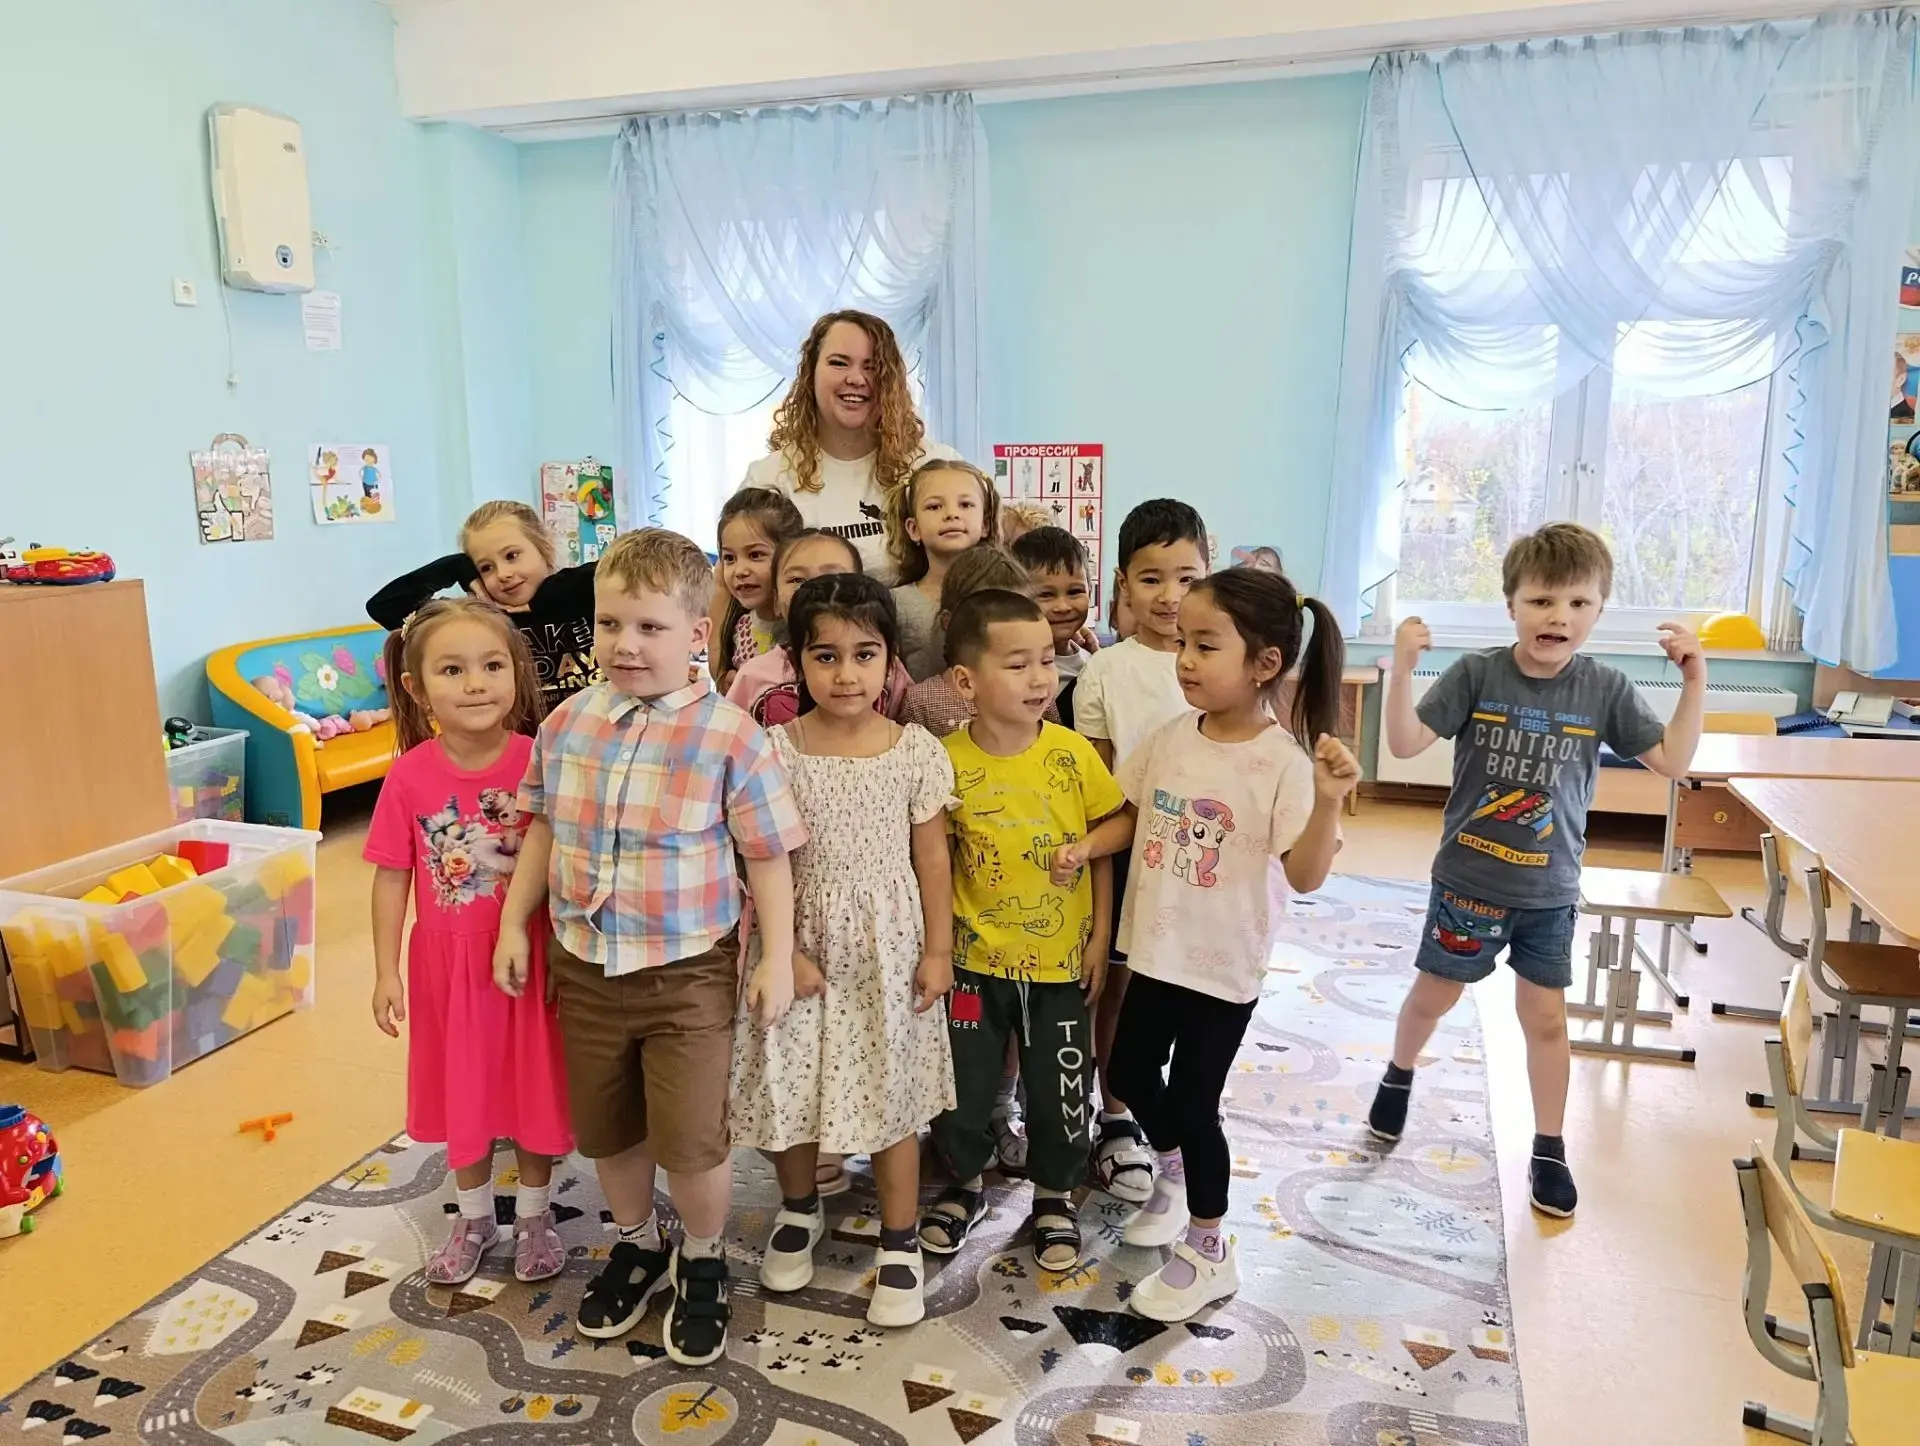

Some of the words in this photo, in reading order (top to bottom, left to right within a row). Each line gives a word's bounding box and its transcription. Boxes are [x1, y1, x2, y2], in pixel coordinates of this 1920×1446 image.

[1904, 271, 1920, 284] Р
[1004, 446, 1079, 457] ПРОФЕССИИ
[1480, 701, 1510, 713] NEXT
[1513, 706, 1550, 720] LEVEL
[1554, 712, 1591, 726] SKILLS
[1474, 723, 1581, 762] CONTROL
[1486, 752, 1564, 788] BREAK
[1460, 834, 1500, 855] GAME
[1504, 850, 1546, 864] OVER
[1443, 890, 1508, 919] Fishing
[950, 1019, 980, 1030] GER
[1057, 1020, 1084, 1144] TOMMY
